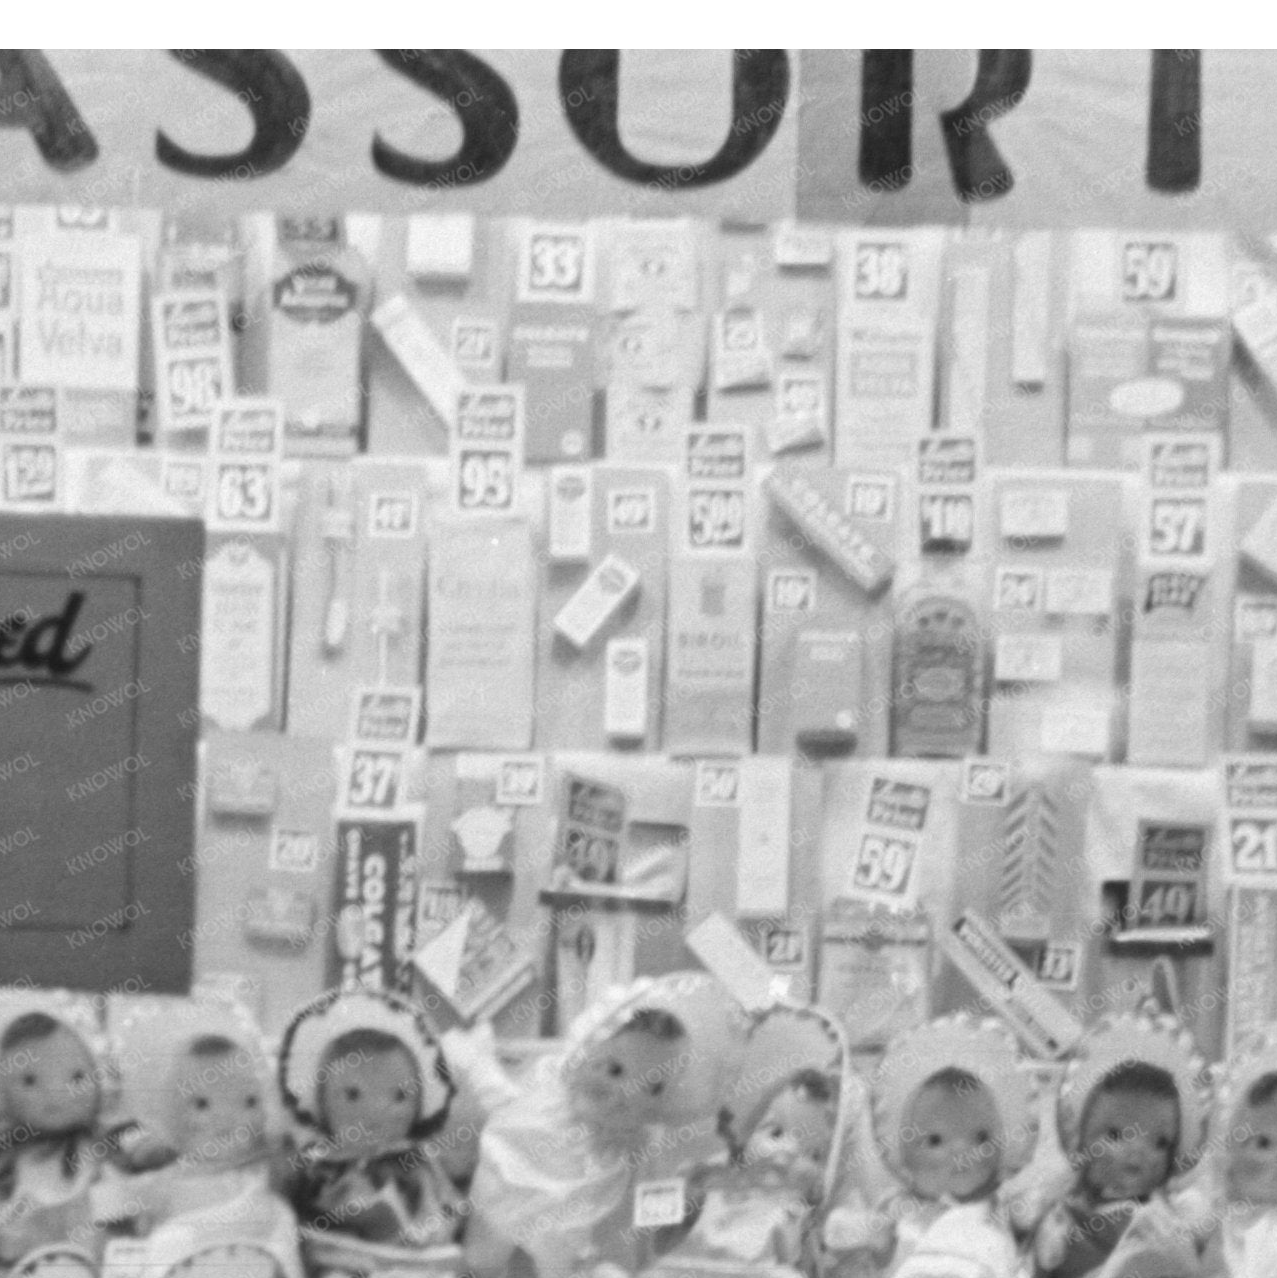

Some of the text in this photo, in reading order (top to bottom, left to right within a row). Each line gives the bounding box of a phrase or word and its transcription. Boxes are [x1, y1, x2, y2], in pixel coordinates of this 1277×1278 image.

[532, 239, 581, 290] 33
[1125, 246, 1174, 298] 59
[1152, 504, 1204, 553] 57
[855, 836, 913, 893] 59
